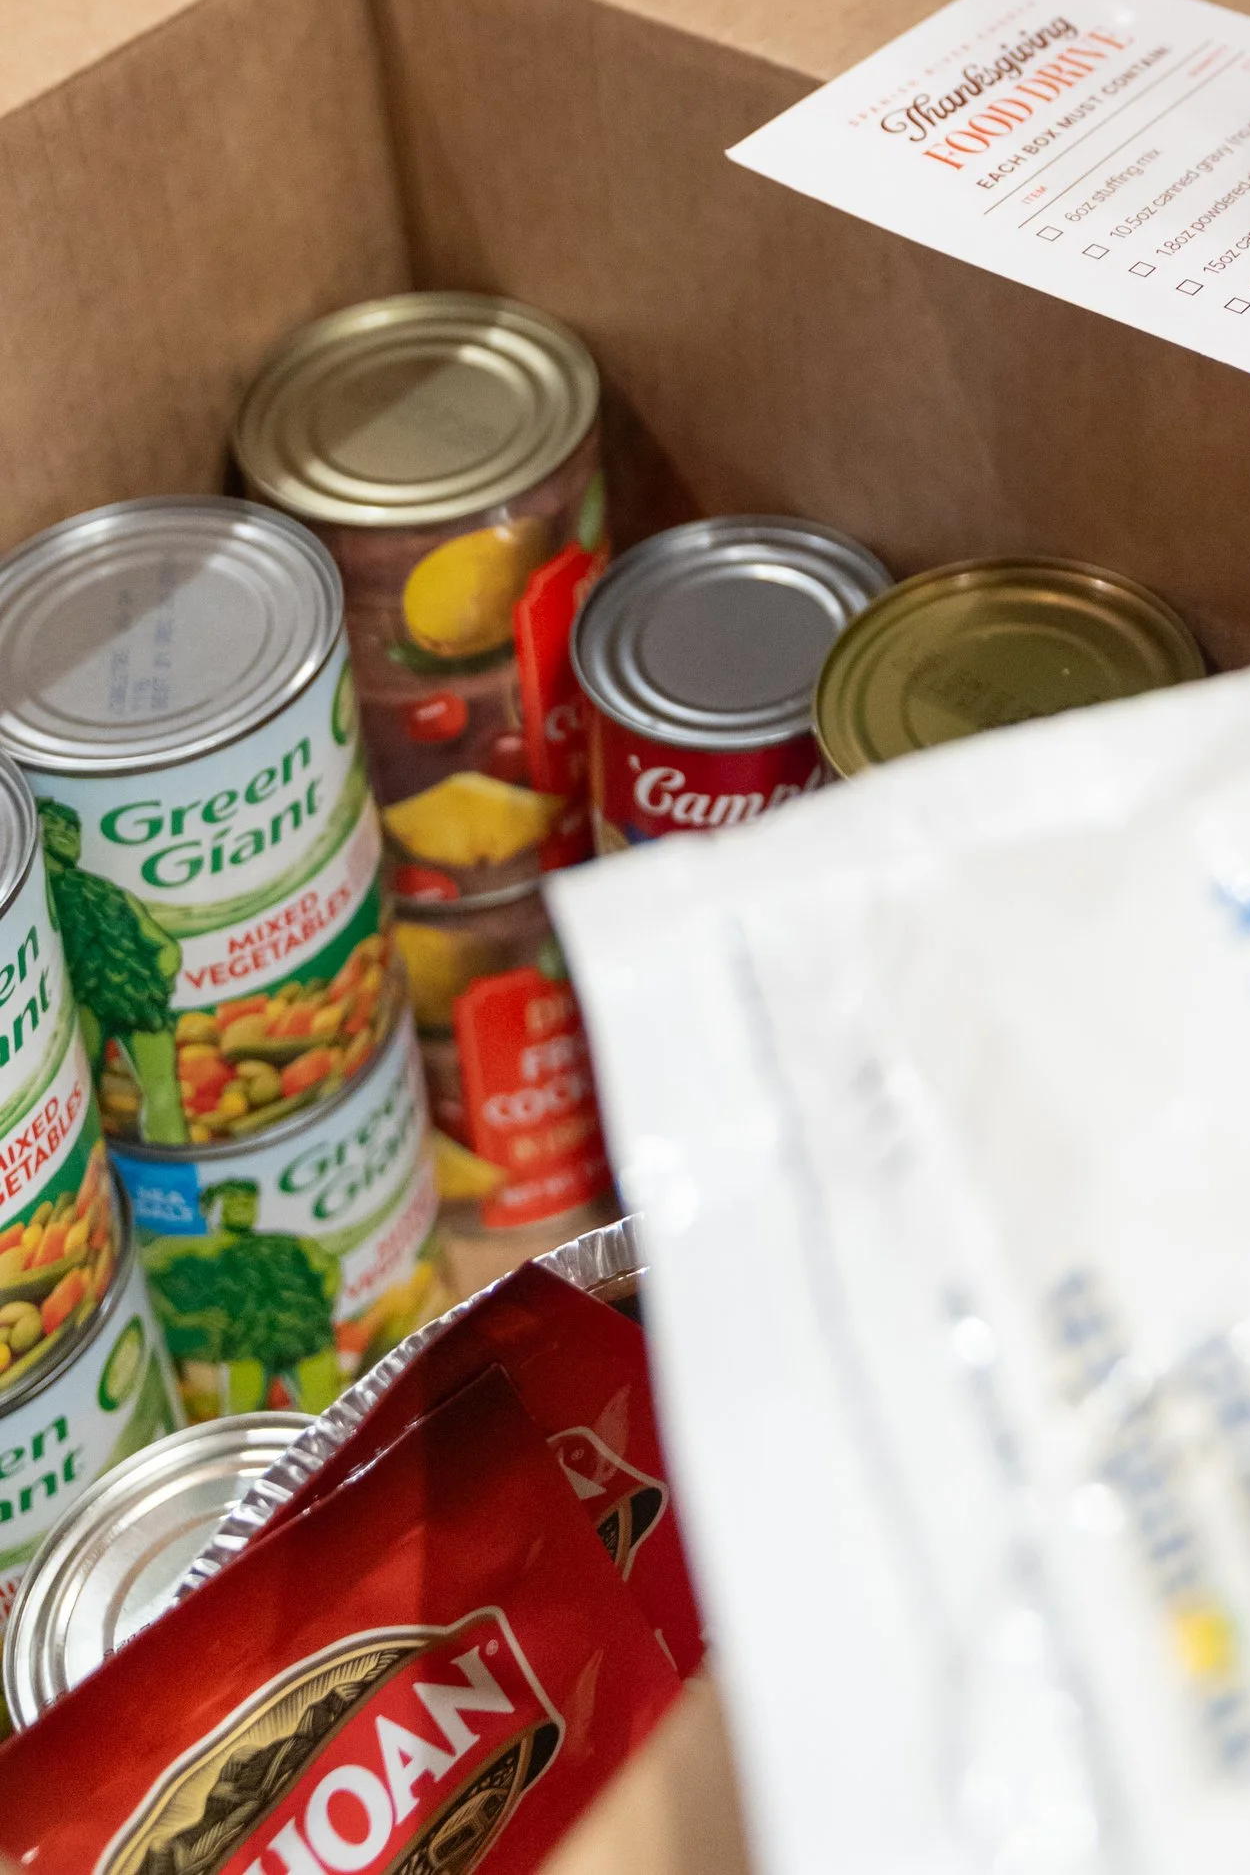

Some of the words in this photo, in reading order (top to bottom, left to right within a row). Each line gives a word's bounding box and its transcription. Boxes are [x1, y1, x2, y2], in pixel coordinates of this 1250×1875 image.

[878, 16, 1078, 143] Thanksgiving
[921, 97, 1034, 171] FOOD
[1014, 25, 1135, 104] DRIVE
[974, 153, 1027, 190] EACH
[1020, 127, 1060, 156] BOX
[1054, 94, 1101, 130] MUST
[1063, 200, 1097, 222] 6oz
[1090, 164, 1145, 203] stuffing
[1134, 147, 1161, 167] mix
[1020, 184, 1049, 205] ITEM
[1108, 204, 1158, 239] 10.5oz
[1150, 168, 1201, 208] canned
[1194, 143, 1235, 174] gravy
[1154, 228, 1197, 256] 1.8oz
[1201, 247, 1242, 274] 15oz
[99, 736, 311, 846] Green
[140, 775, 324, 888] Giant
[184, 883, 352, 991] VEGETABLES
[228, 891, 318, 955] MIXED
[0, 1079, 82, 1208] ETABLES
